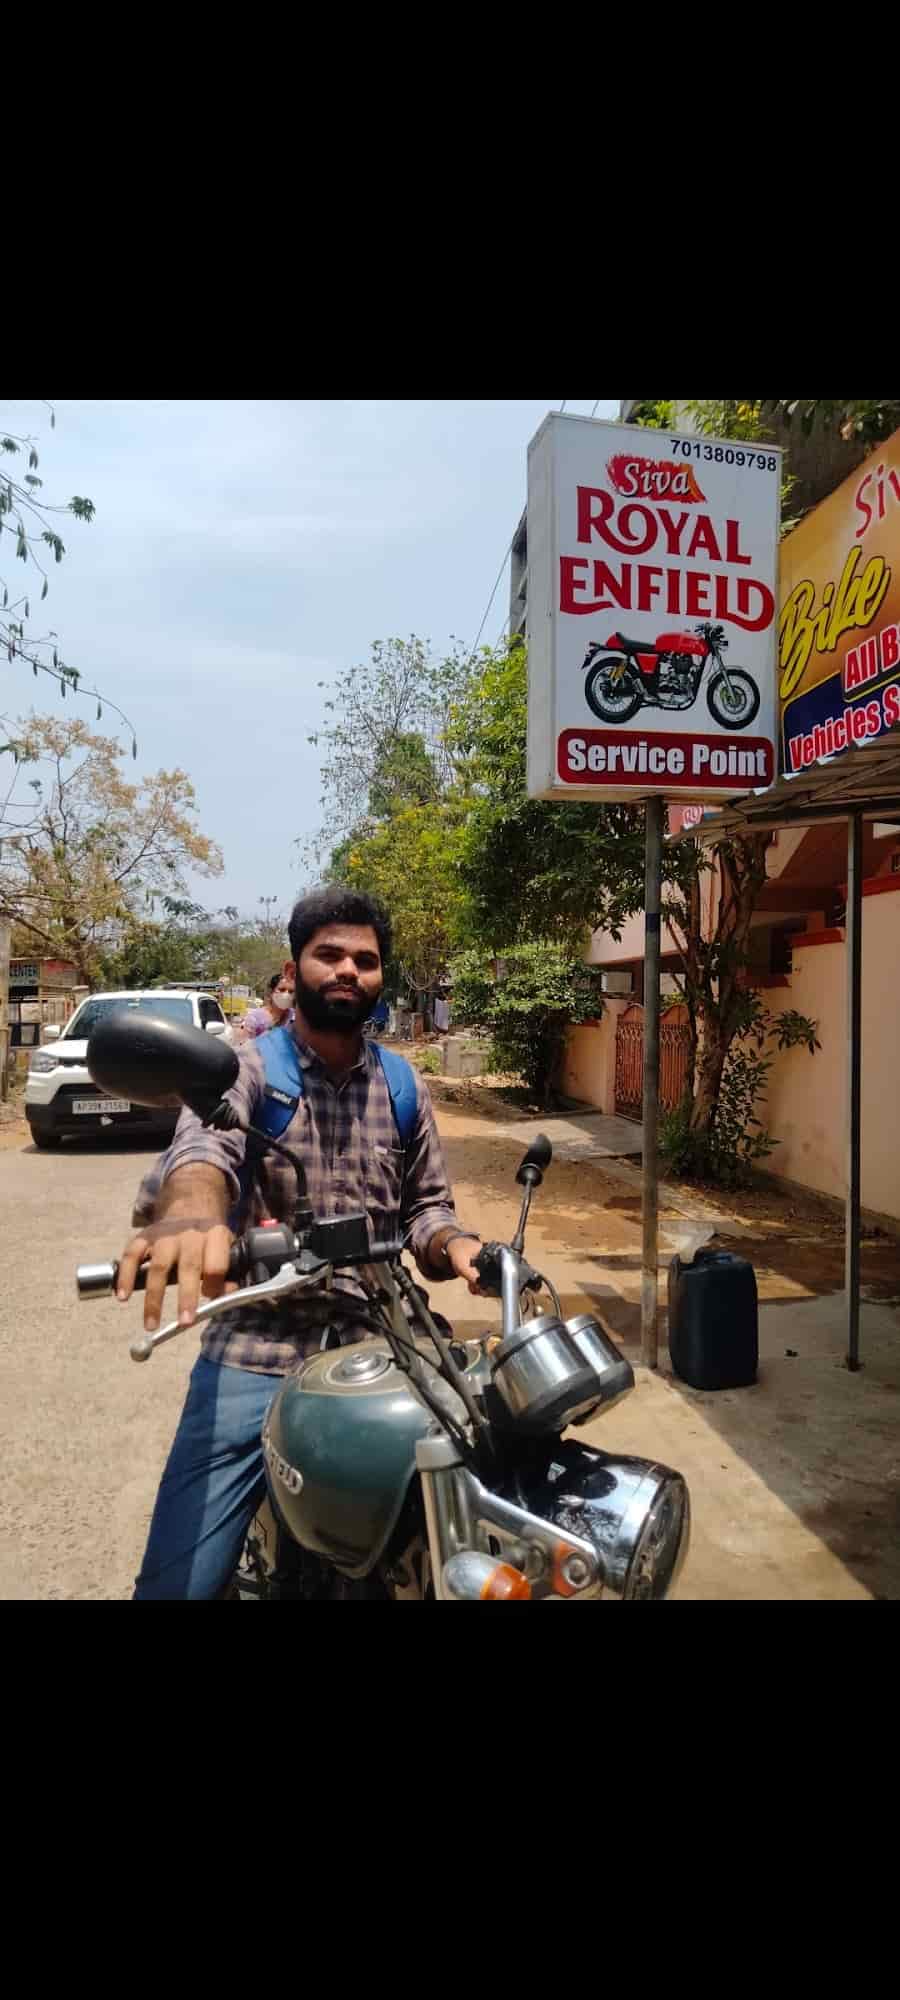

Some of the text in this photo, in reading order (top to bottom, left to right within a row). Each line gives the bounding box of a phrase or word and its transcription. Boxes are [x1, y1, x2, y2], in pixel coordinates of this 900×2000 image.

[620, 462, 691, 497] Siva
[671, 439, 777, 472] 7013809798
[576, 486, 752, 565] ROYAL
[559, 555, 775, 632] ENFIELD
[779, 545, 891, 700] Bike
[844, 636, 878, 692] All
[567, 738, 767, 777] Service Point
[789, 701, 881, 771] Vehicles
